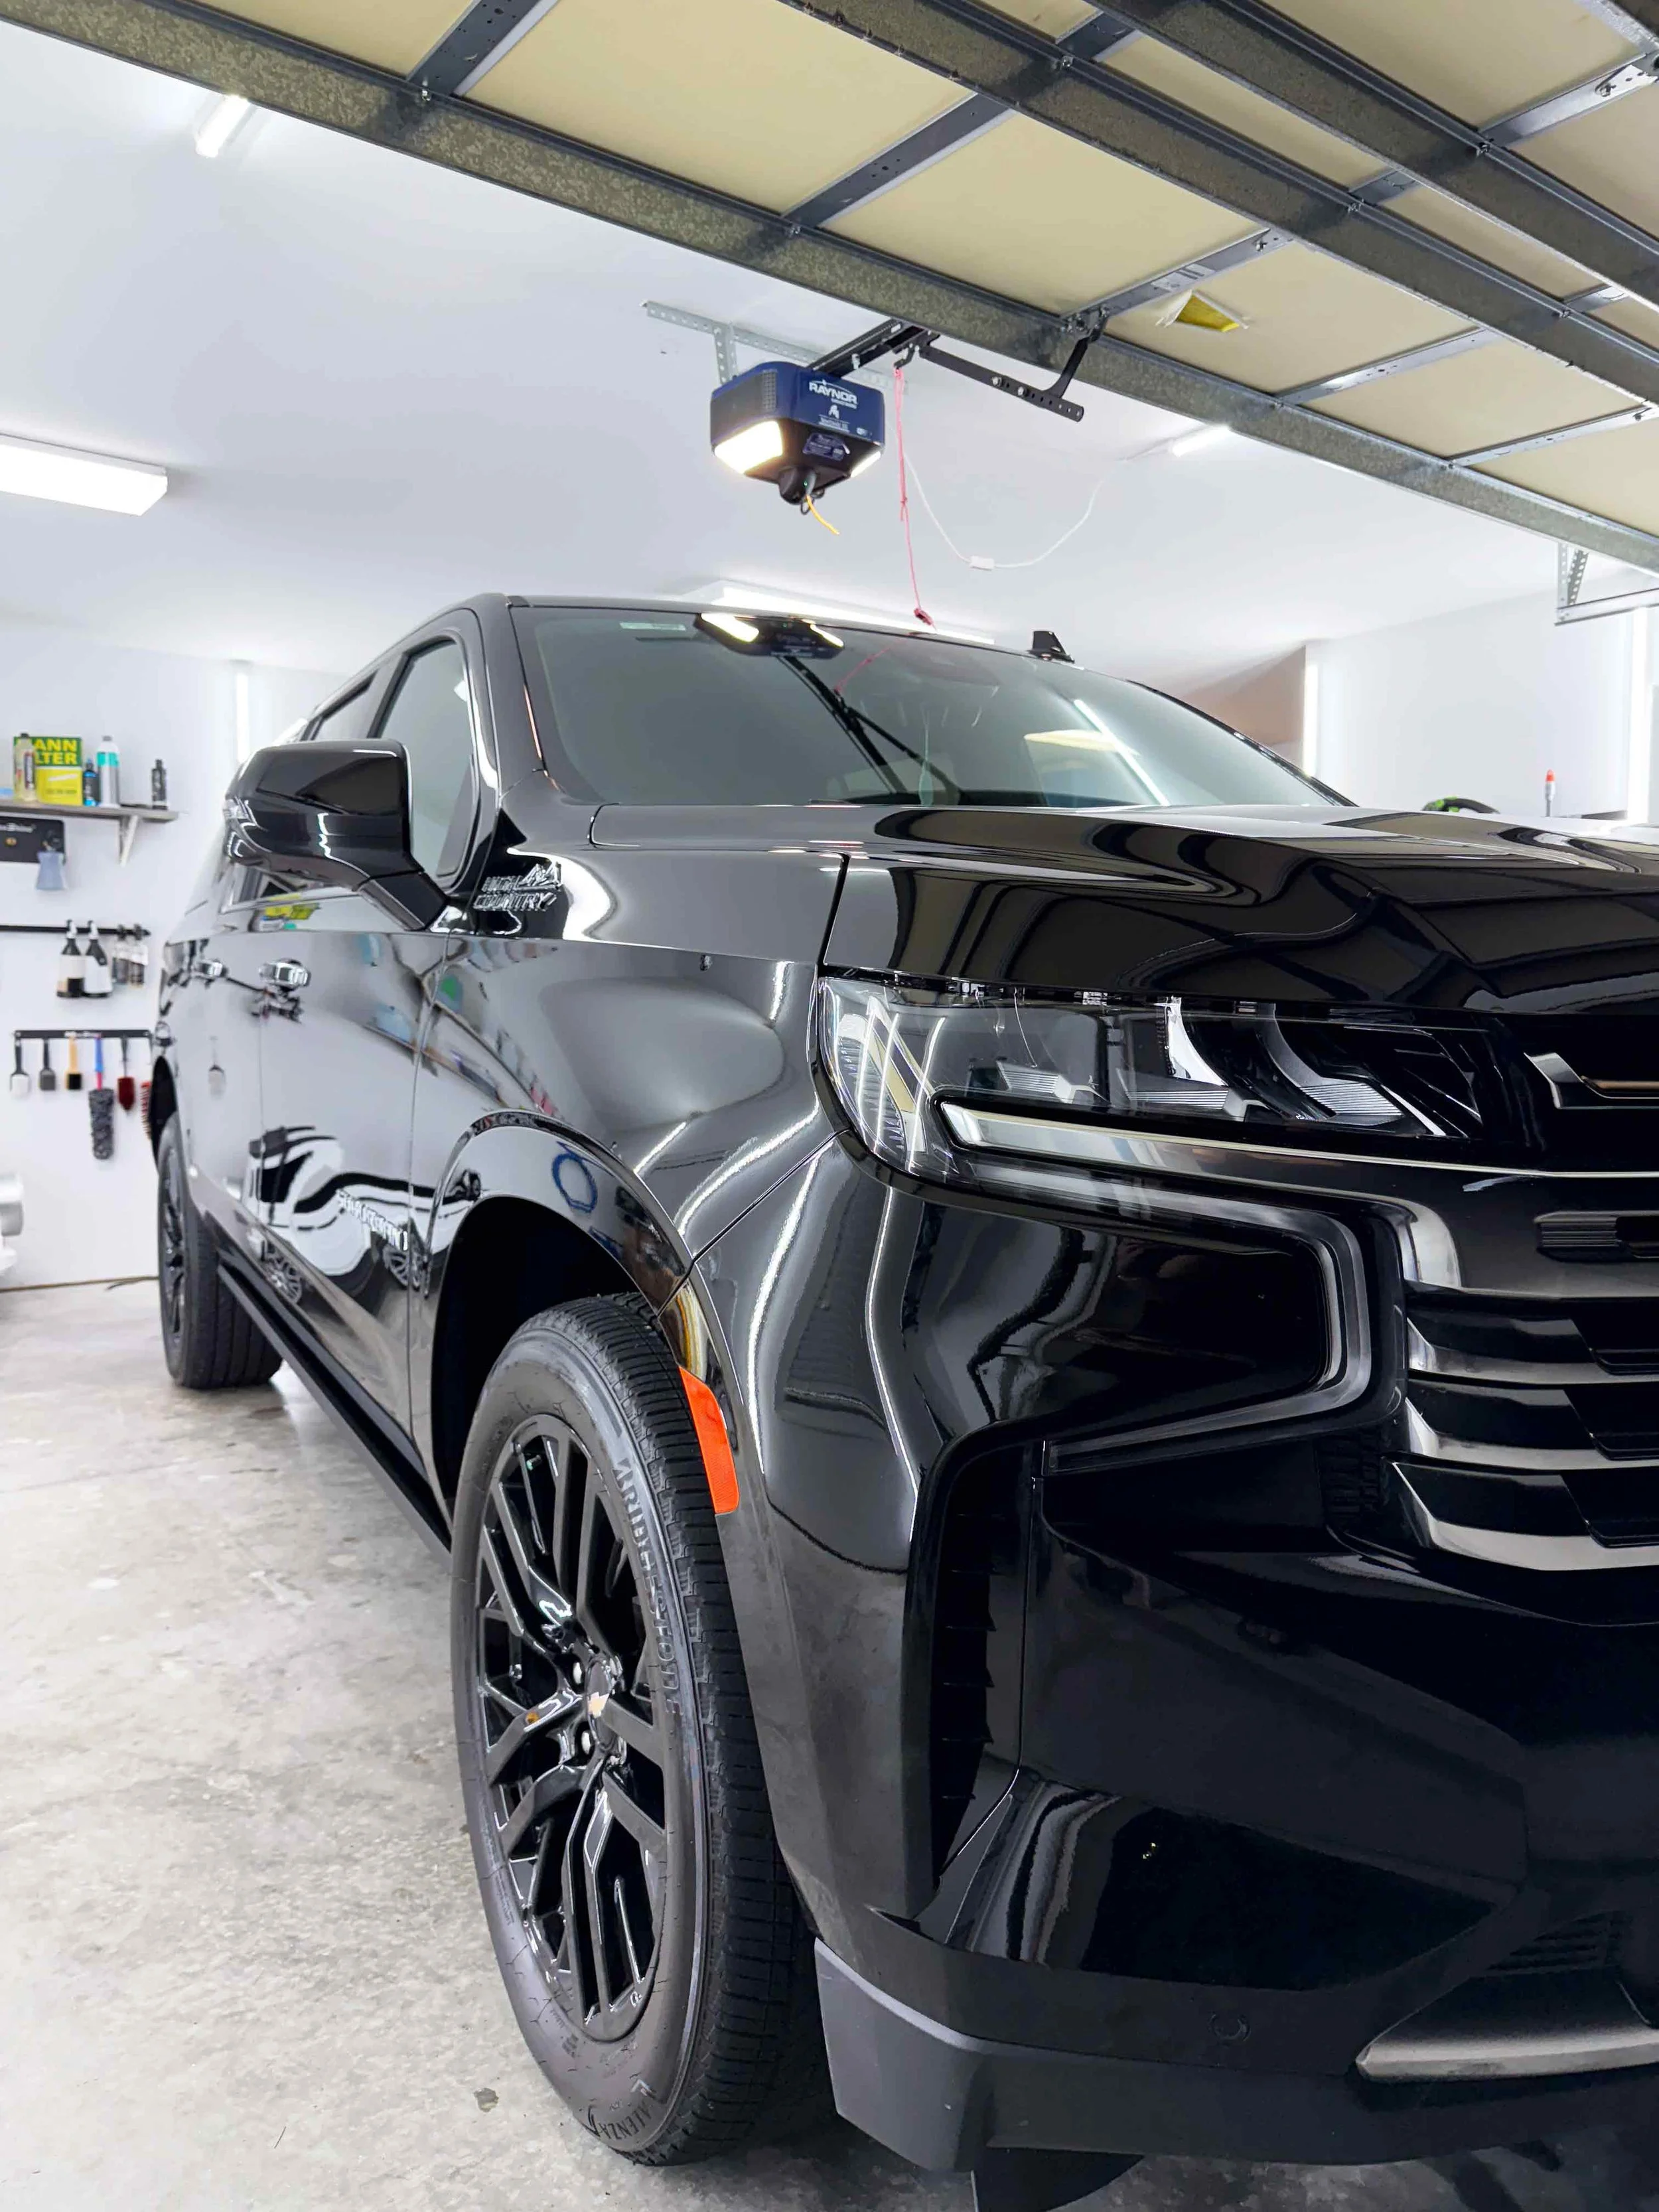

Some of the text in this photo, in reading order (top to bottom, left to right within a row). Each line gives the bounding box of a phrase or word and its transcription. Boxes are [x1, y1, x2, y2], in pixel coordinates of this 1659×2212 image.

[809, 382, 857, 404] RAYNOR
[33, 739, 78, 753] ANN
[35, 751, 78, 765] LTER
[472, 891, 557, 912] COUNTRY
[612, 1457, 684, 1717] BRIDGESTONE
[599, 2101, 652, 2140] ALENZA
